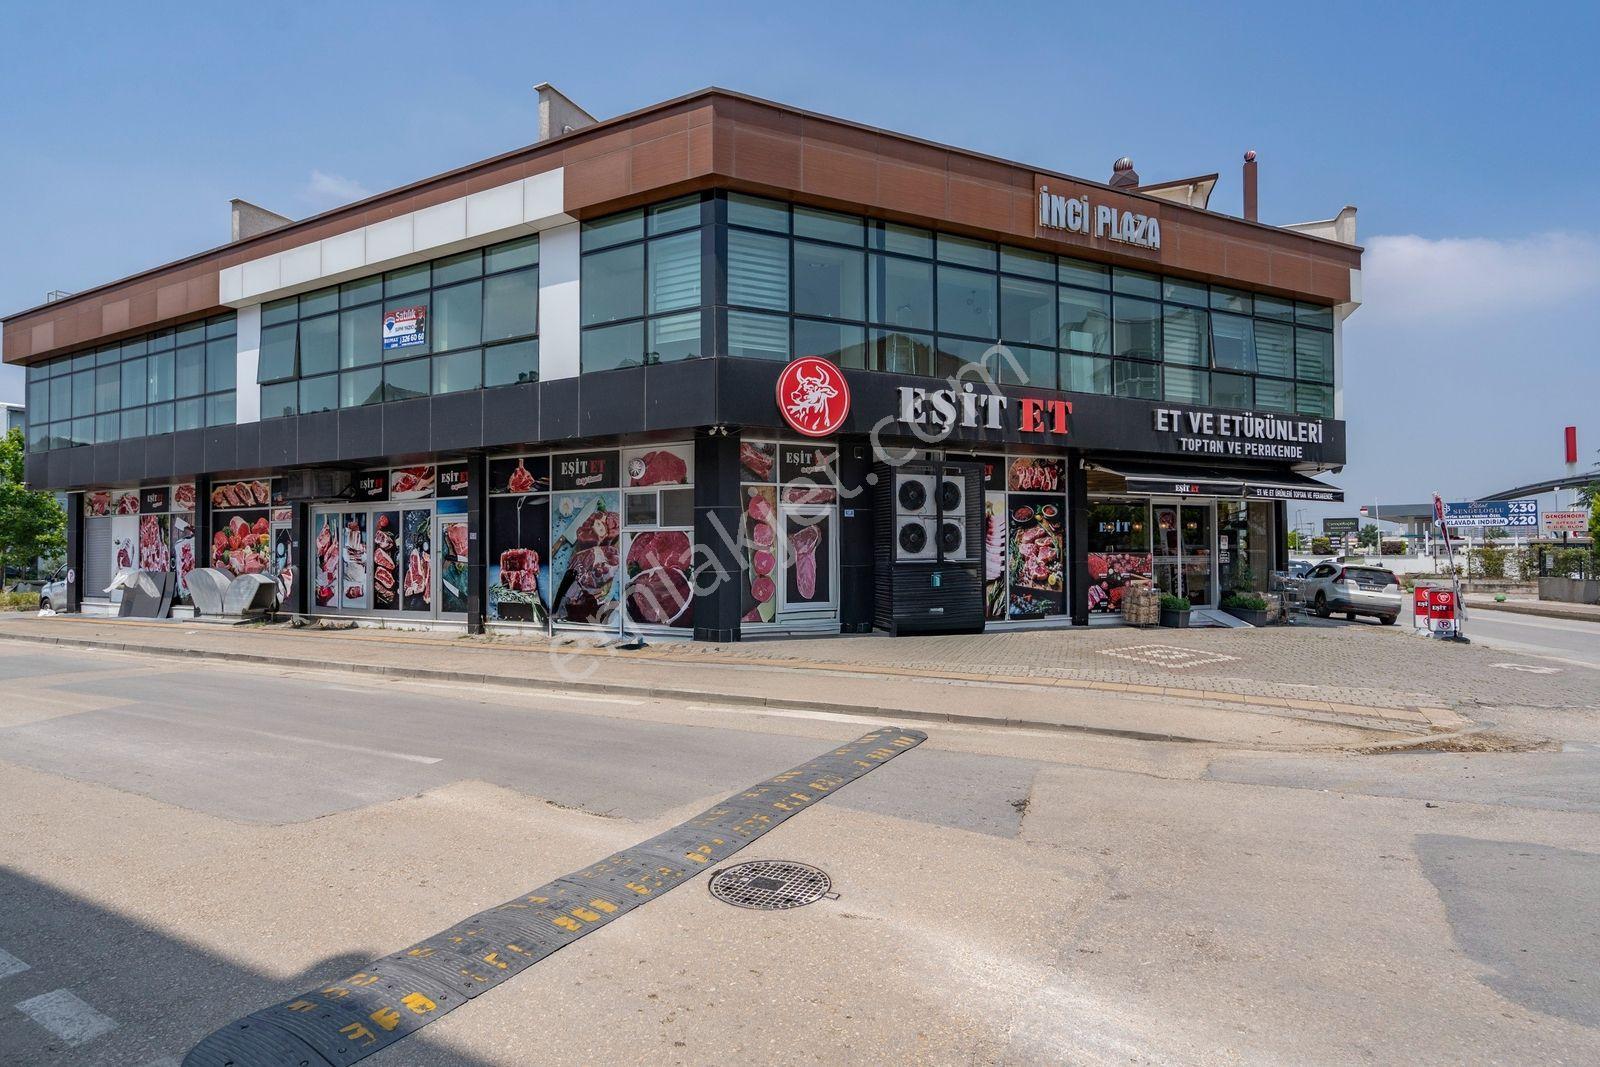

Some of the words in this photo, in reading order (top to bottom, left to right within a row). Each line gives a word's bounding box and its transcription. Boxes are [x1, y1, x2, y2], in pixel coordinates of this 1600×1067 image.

[1040, 185, 1089, 235] İNCİ
[1094, 205, 1160, 250] PLAZA
[897, 382, 1008, 434] EŞİT
[1018, 398, 1074, 435] ET
[1156, 408, 1183, 432] ET
[1187, 411, 1215, 436] VE
[1219, 411, 1324, 444] ETÜRÜNLERİ
[785, 449, 812, 466] EŞİT
[1180, 436, 1224, 453] TOPTAN
[1227, 440, 1243, 455] VE
[1244, 442, 1303, 459] PERAKENDE
[561, 458, 588, 478] EŞİT
[589, 459, 606, 474] ET
[1174, 484, 1190, 495] EŞİT
[1508, 503, 1537, 513] %30
[1508, 515, 1537, 526] %20
